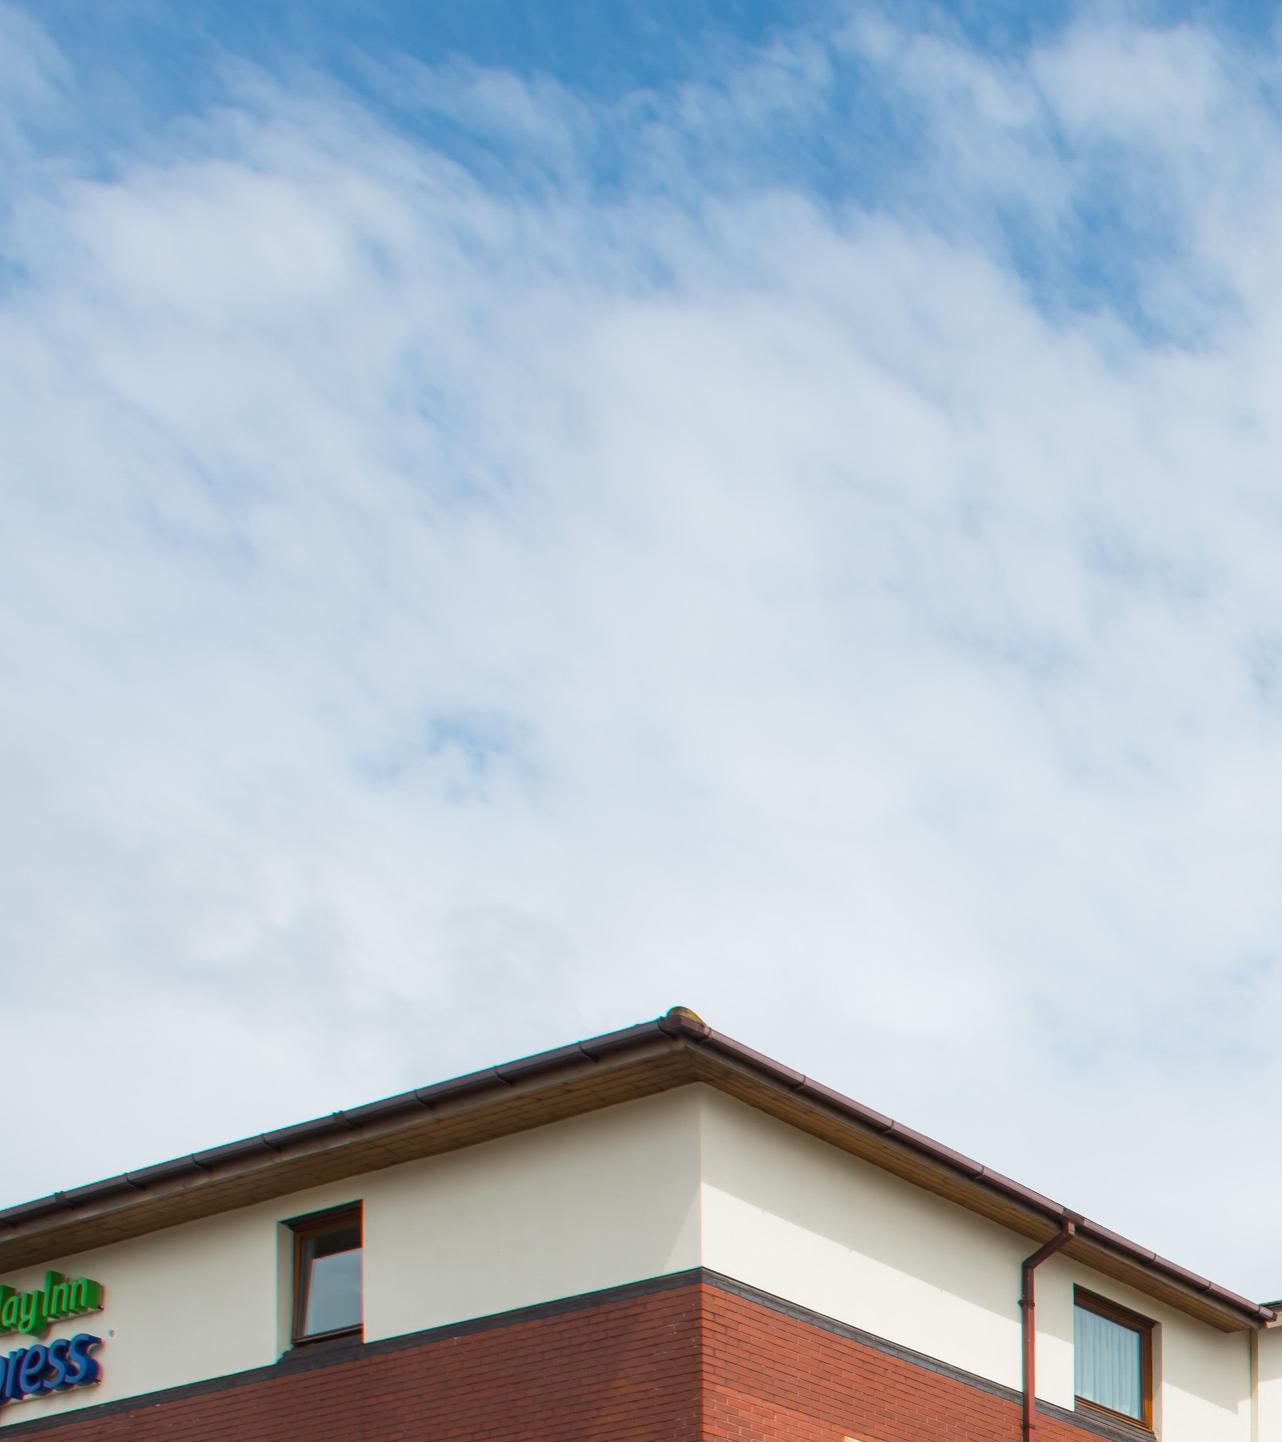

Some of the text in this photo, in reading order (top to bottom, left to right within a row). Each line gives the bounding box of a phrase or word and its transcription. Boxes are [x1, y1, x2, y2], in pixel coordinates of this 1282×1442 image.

[0, 1270, 101, 1336] ay Inn
[0, 1333, 102, 1404] ress
